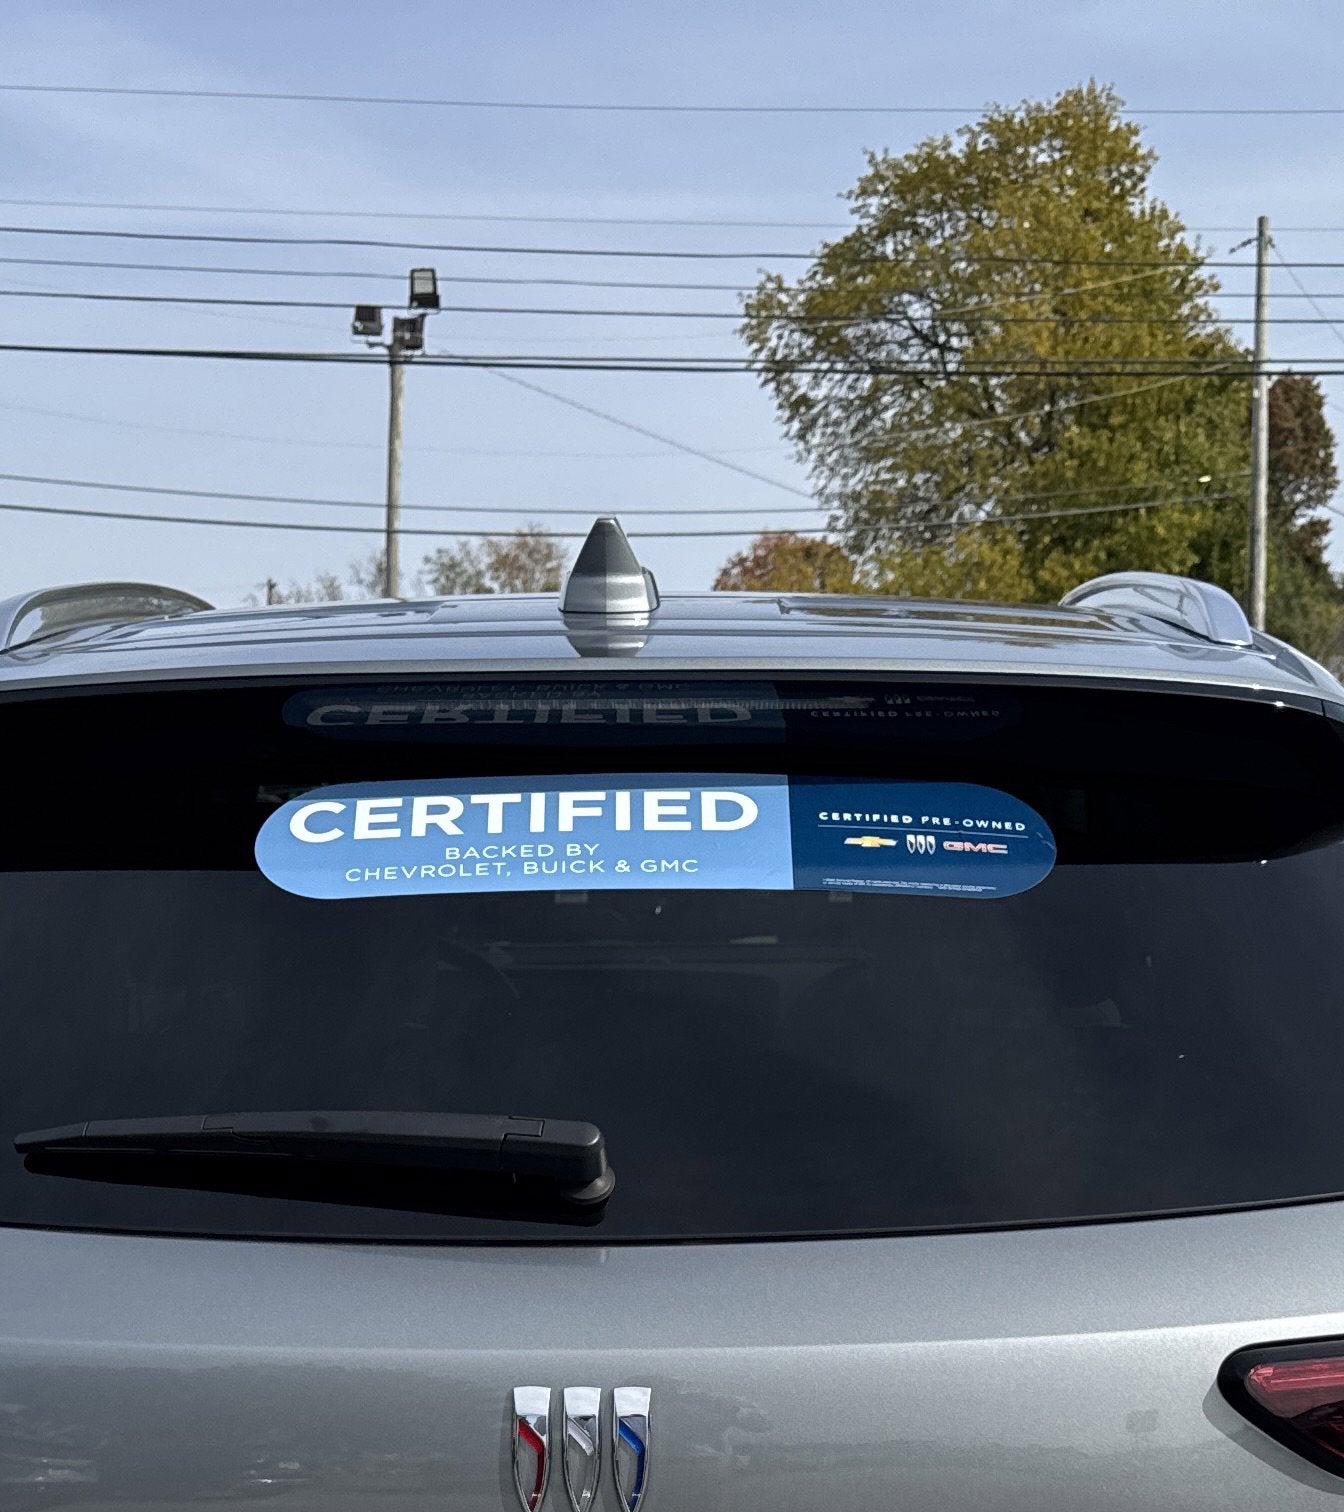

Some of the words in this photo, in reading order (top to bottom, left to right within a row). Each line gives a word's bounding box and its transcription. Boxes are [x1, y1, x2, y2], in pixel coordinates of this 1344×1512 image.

[289, 790, 759, 844] CERTIFIED
[818, 811, 913, 824] CERTIFIED
[921, 815, 1026, 832] PRE-OWNED
[444, 844, 555, 861] BACKED
[566, 843, 600, 857] BY
[942, 840, 1009, 855] GMC
[344, 860, 513, 883] CHEVROLET,
[522, 859, 606, 876] BUICK
[614, 859, 632, 874] &
[639, 858, 700, 874] GMC
